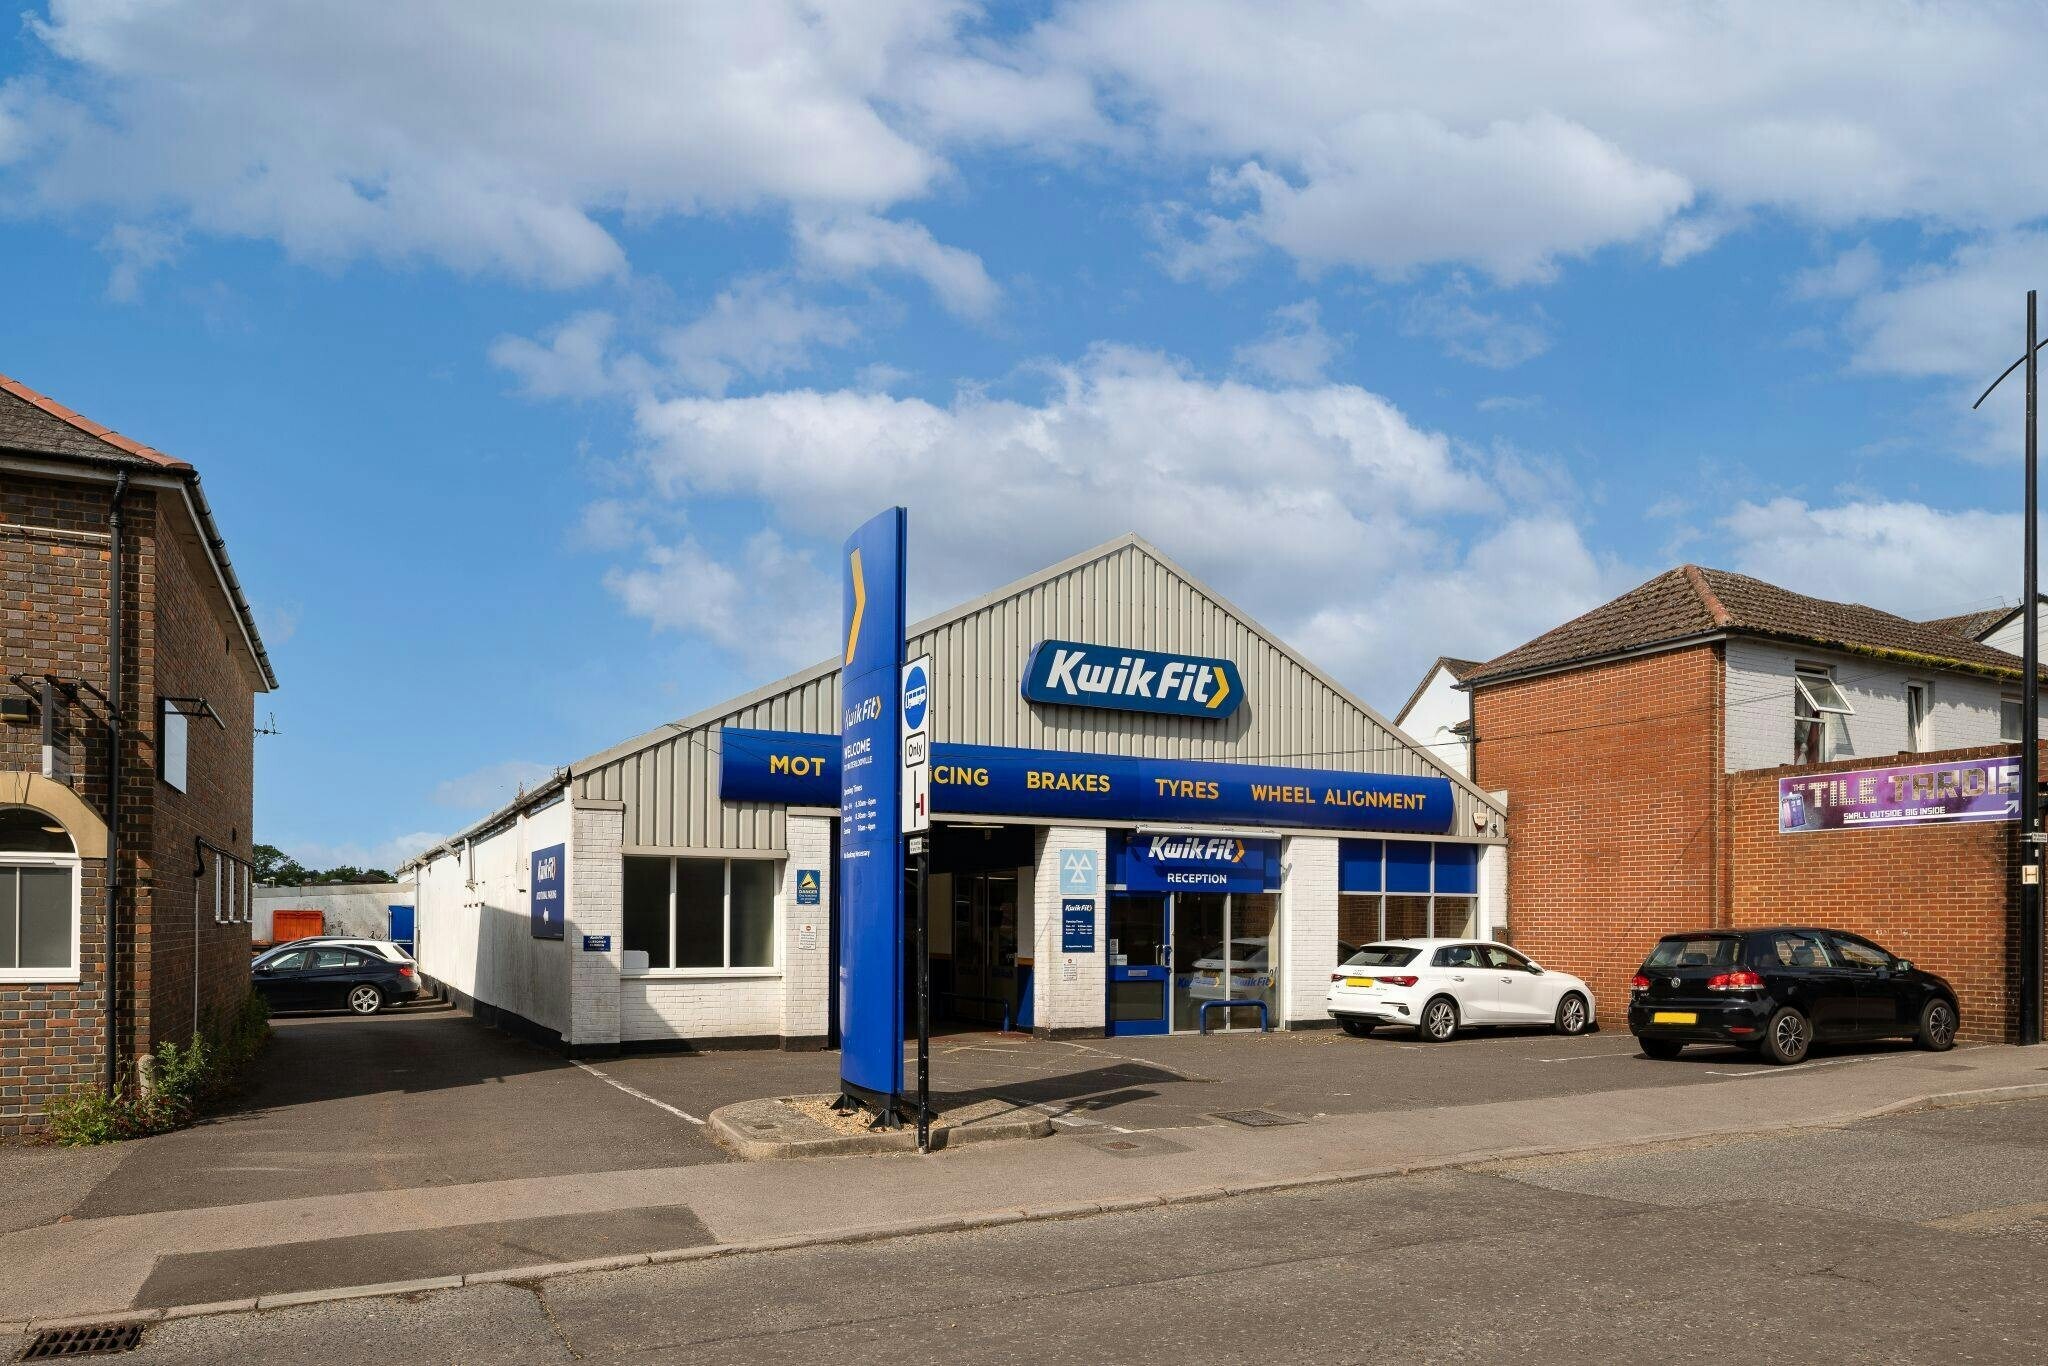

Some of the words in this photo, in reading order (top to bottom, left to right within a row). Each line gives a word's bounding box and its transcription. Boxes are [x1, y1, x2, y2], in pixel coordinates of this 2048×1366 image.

[908, 742, 923, 757] Only
[770, 754, 826, 777] MOT
[1026, 771, 1111, 793] BRAKES
[1155, 778, 1219, 800] TYRES
[1251, 784, 1316, 804] WHEEL
[1324, 788, 1427, 811] ALIGNMENT
[1792, 783, 1806, 792] THE
[1808, 776, 1878, 808] TILE
[1888, 764, 2020, 802] TARDIS
[1843, 811, 1868, 820] SMALL
[1870, 809, 1903, 819] OUTSIDE
[1905, 807, 1918, 816] BIG
[1919, 806, 1946, 815] INSIDE
[1167, 873, 1227, 884] RECEPTION
